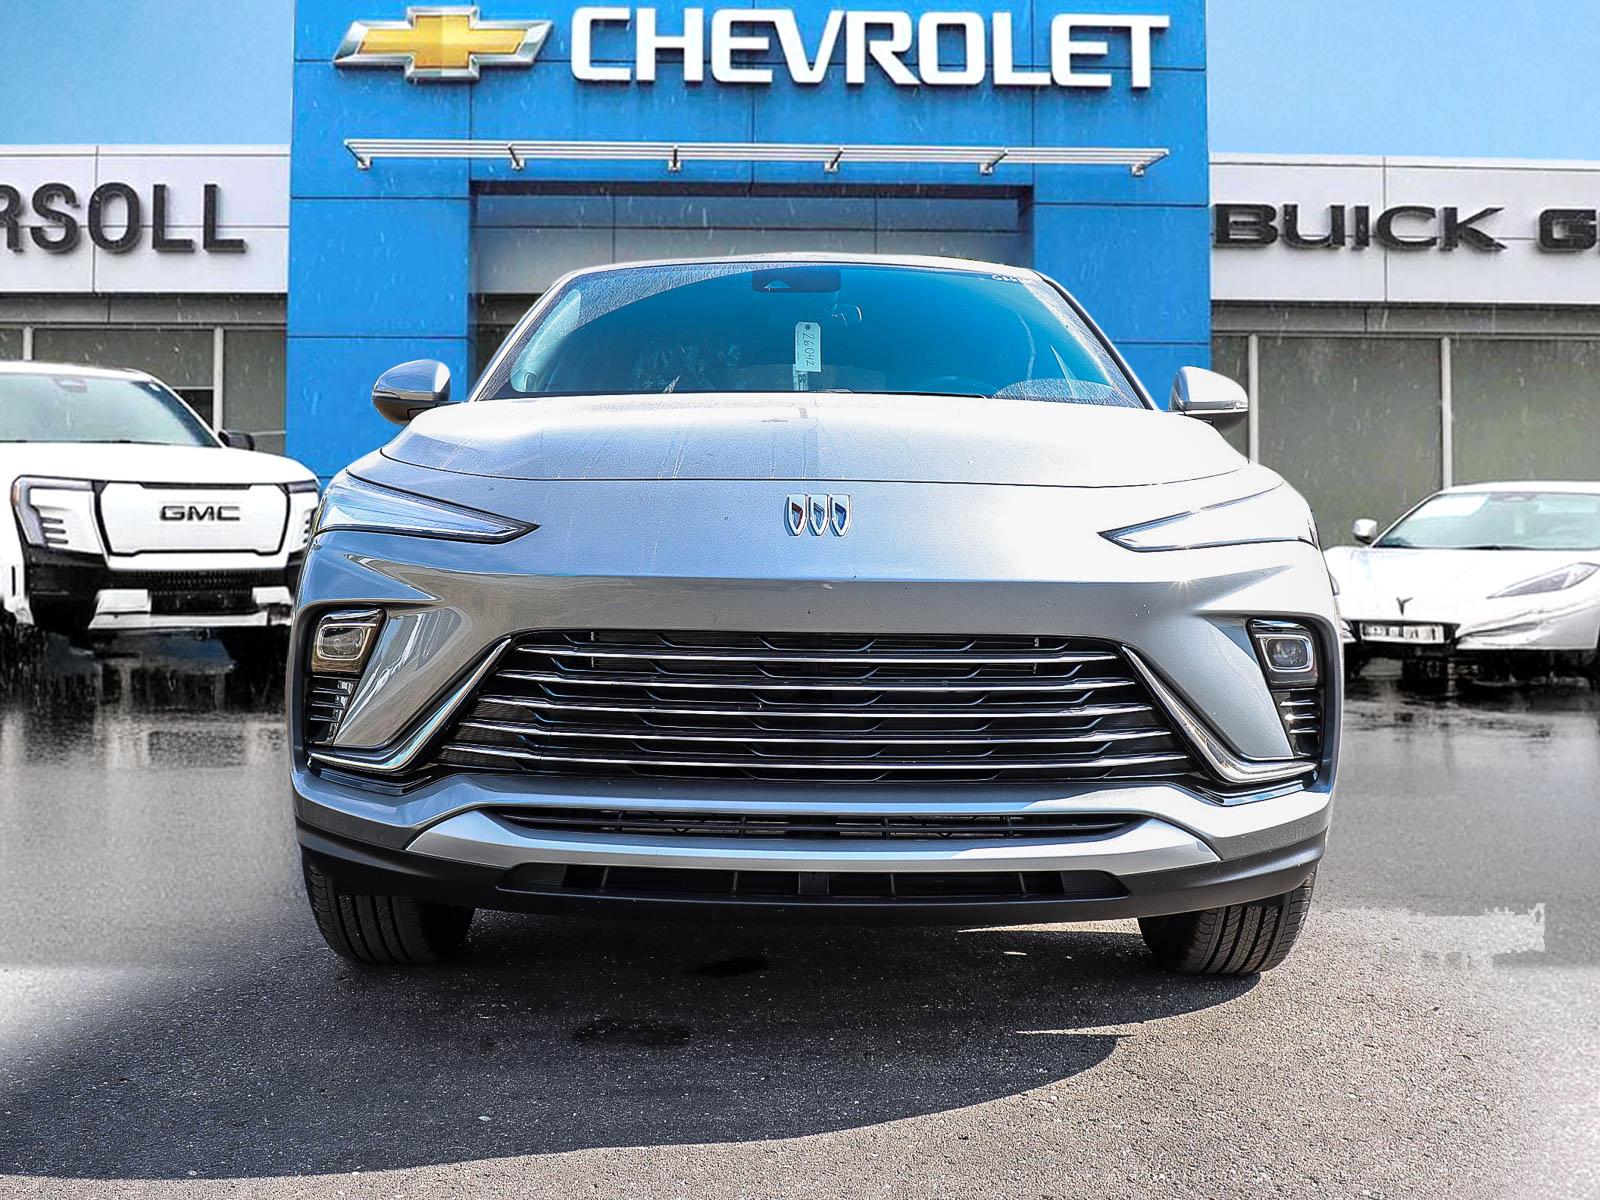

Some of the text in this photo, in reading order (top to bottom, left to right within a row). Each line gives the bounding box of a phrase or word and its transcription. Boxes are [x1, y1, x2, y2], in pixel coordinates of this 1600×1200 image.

[570, 7, 1170, 88] CHEVROLET
[1213, 203, 1600, 254] BUICK G
[802, 331, 816, 367] 26042
[160, 505, 241, 521] GMC
